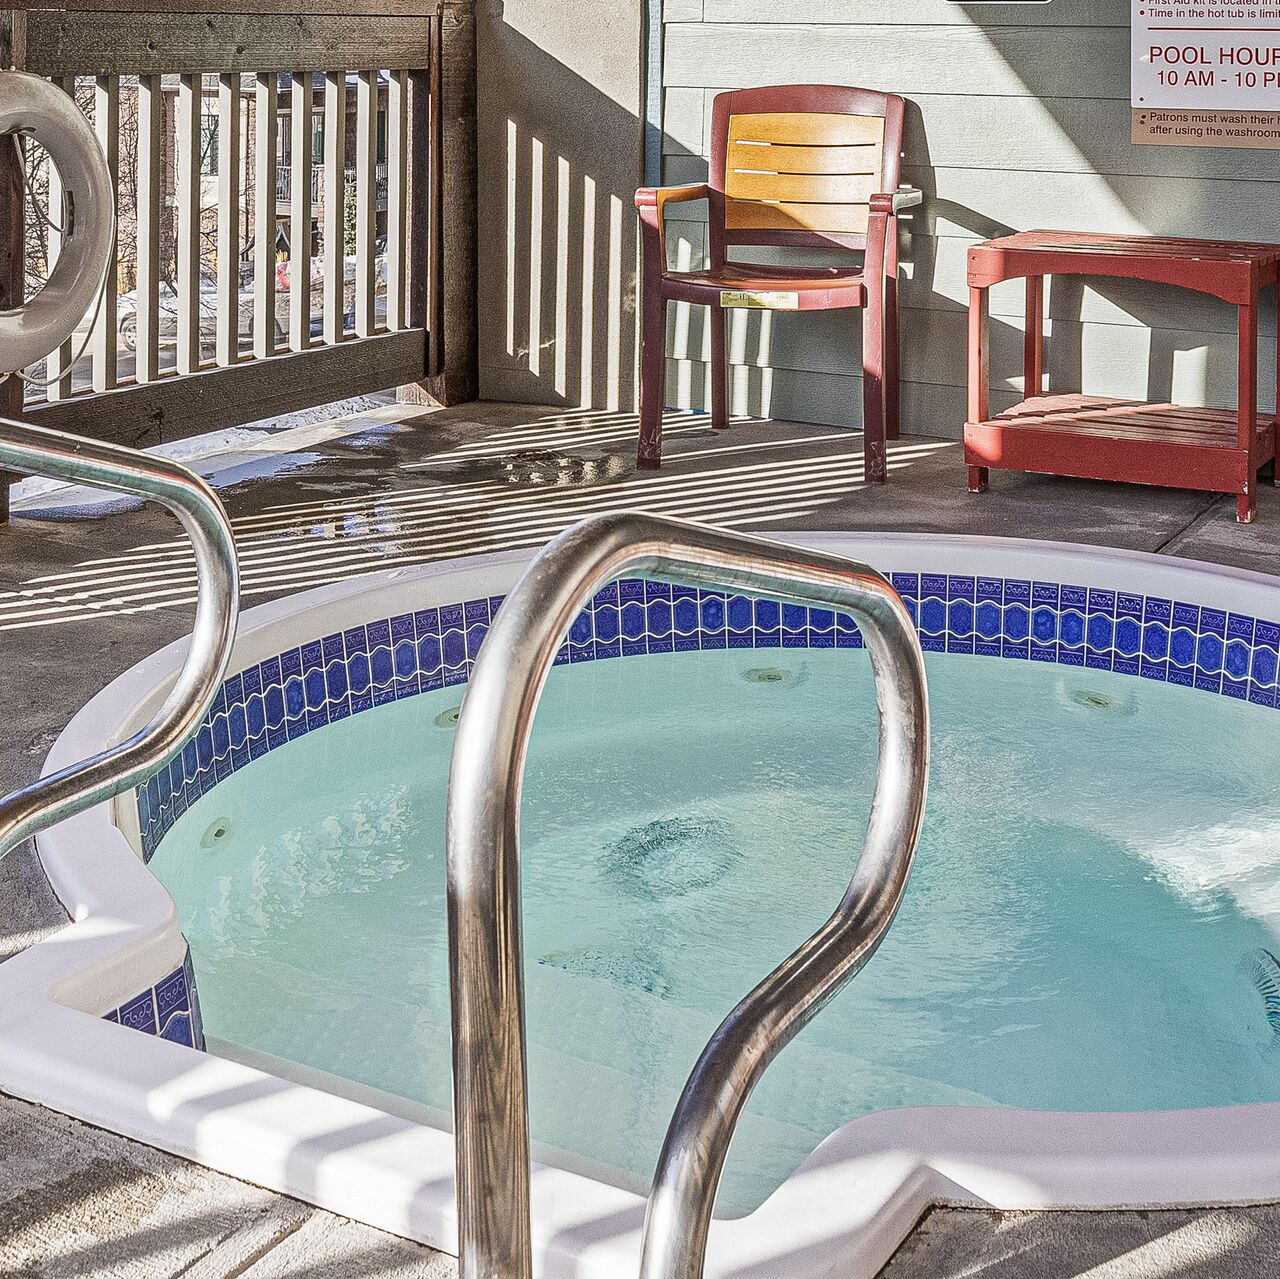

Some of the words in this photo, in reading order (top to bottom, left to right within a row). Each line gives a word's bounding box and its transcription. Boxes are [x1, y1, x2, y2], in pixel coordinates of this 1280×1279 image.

[1147, 8, 1173, 17] Time
[1176, 8, 1185, 17] in
[1188, 8, 1204, 18] the
[1207, 8, 1224, 18] hot
[1227, 8, 1244, 18] tub
[1247, 8, 1256, 18] is
[1149, 45, 1212, 64] POOL
[1157, 70, 1178, 86] 10
[1183, 70, 1214, 86] AM
[1234, 71, 1256, 88] 10
[1150, 111, 1188, 122] Patrons
[1191, 114, 1217, 123] must
[1219, 114, 1247, 124] wash
[1250, 114, 1274, 125] their
[1149, 124, 1172, 134] after
[1175, 125, 1203, 138] using
[1206, 126, 1222, 136] the
[1225, 127, 1280, 138] washroom
